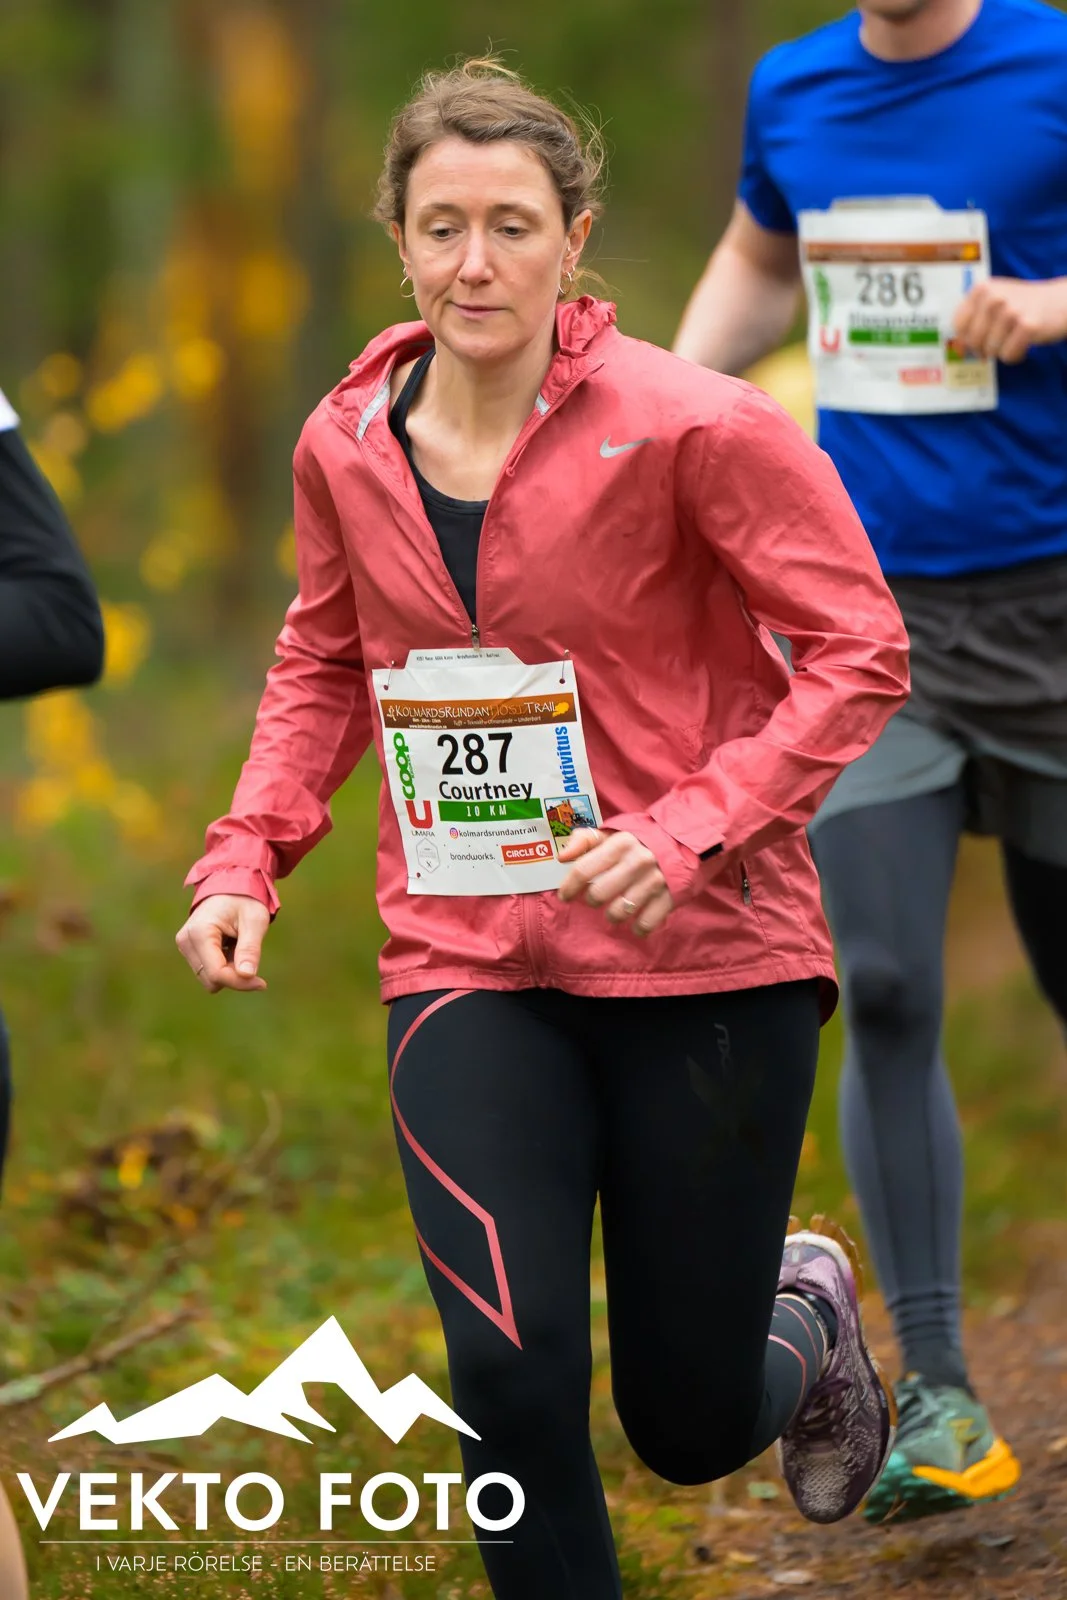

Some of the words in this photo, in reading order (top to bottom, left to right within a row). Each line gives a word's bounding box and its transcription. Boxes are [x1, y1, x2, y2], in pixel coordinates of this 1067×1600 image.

[855, 267, 924, 307] 286
[437, 732, 513, 776] 287
[555, 726, 580, 793] Aktivitus
[439, 780, 533, 802] Courtney
[466, 805, 480, 817] 10
[489, 804, 507, 816] KM
[505, 847, 535, 858] CIRCLE
[536, 844, 548, 856] K
